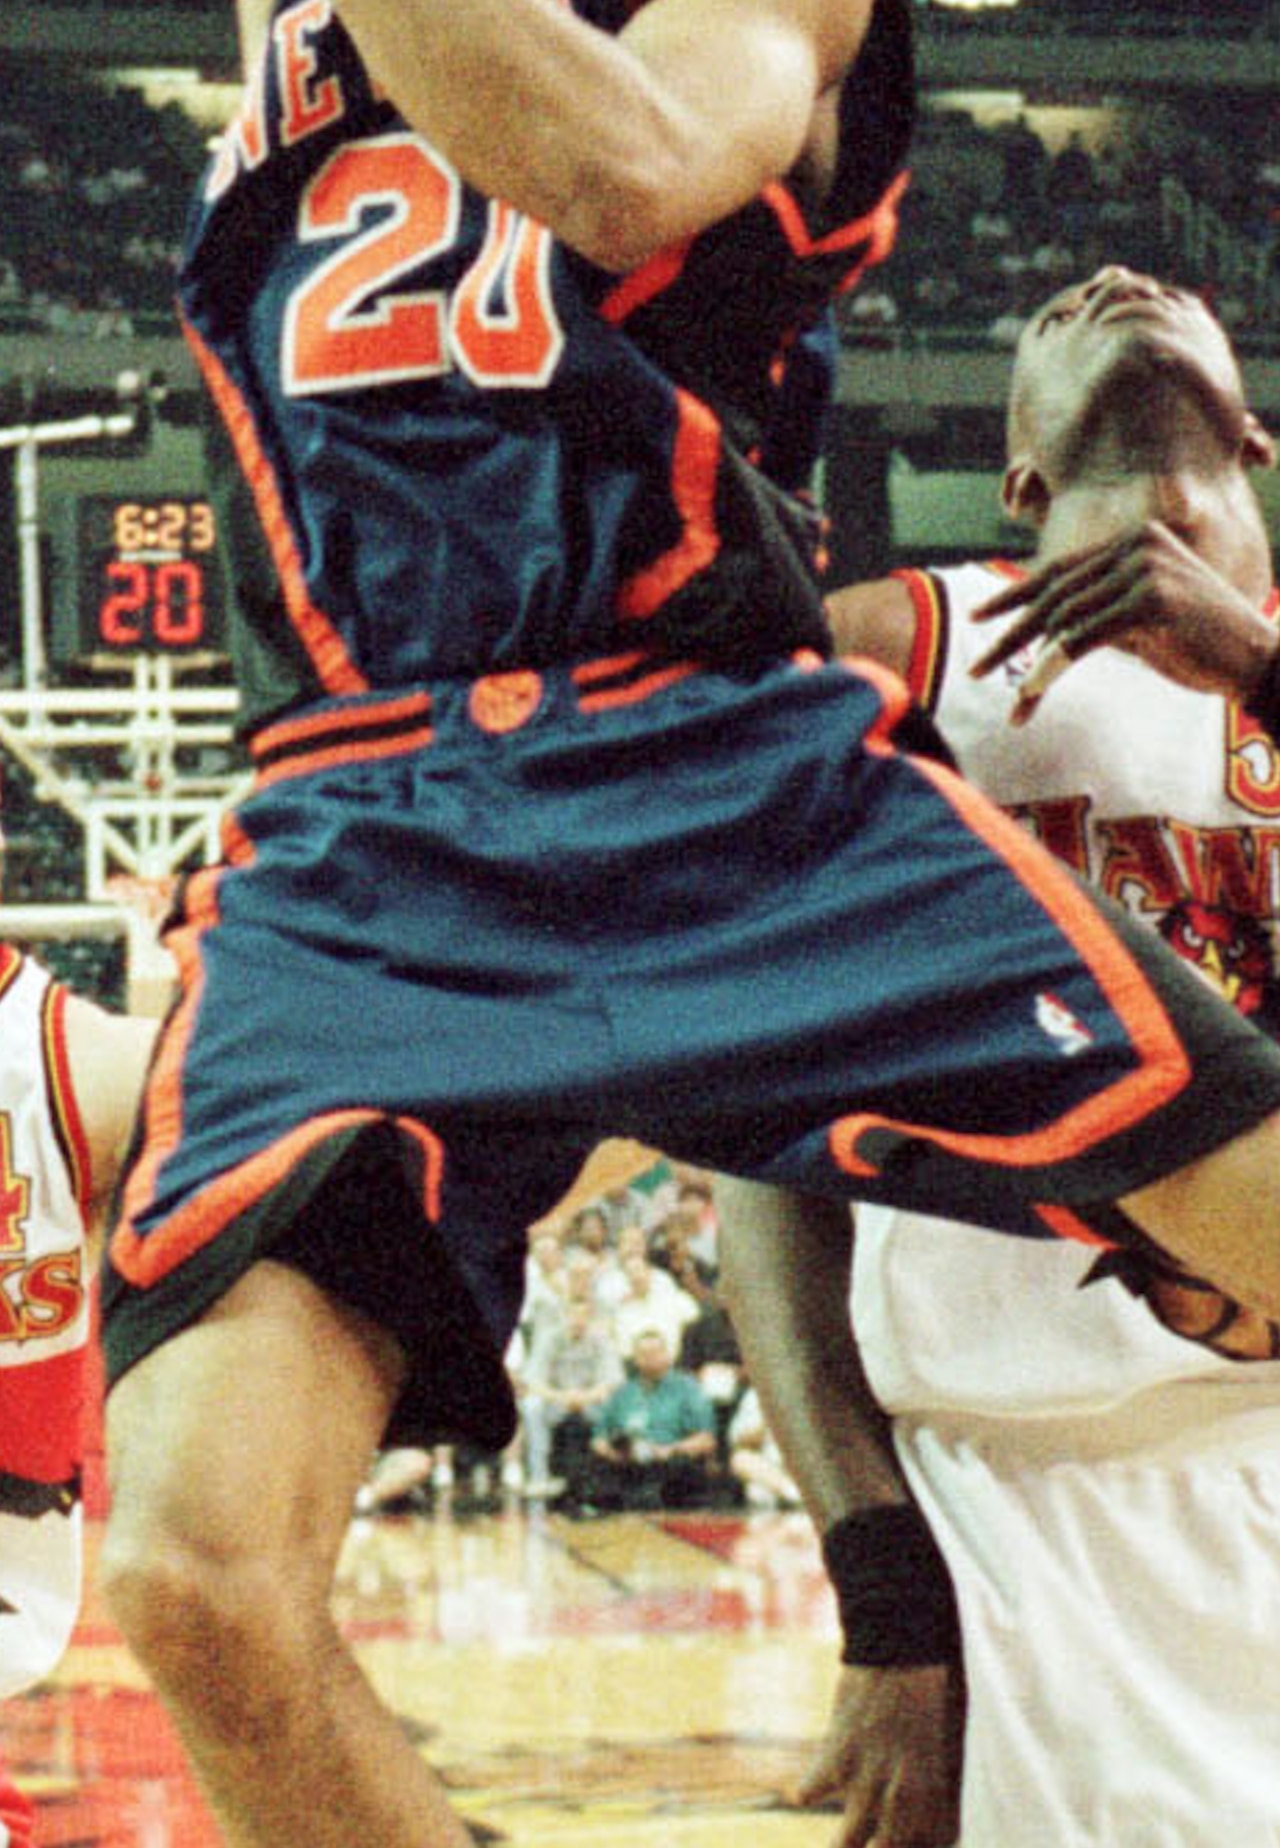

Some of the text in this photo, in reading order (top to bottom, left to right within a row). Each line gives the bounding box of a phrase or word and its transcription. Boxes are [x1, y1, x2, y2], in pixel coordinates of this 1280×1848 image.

[281, 131, 566, 398] 20
[114, 502, 215, 552] 6:23
[101, 561, 203, 644] 20
